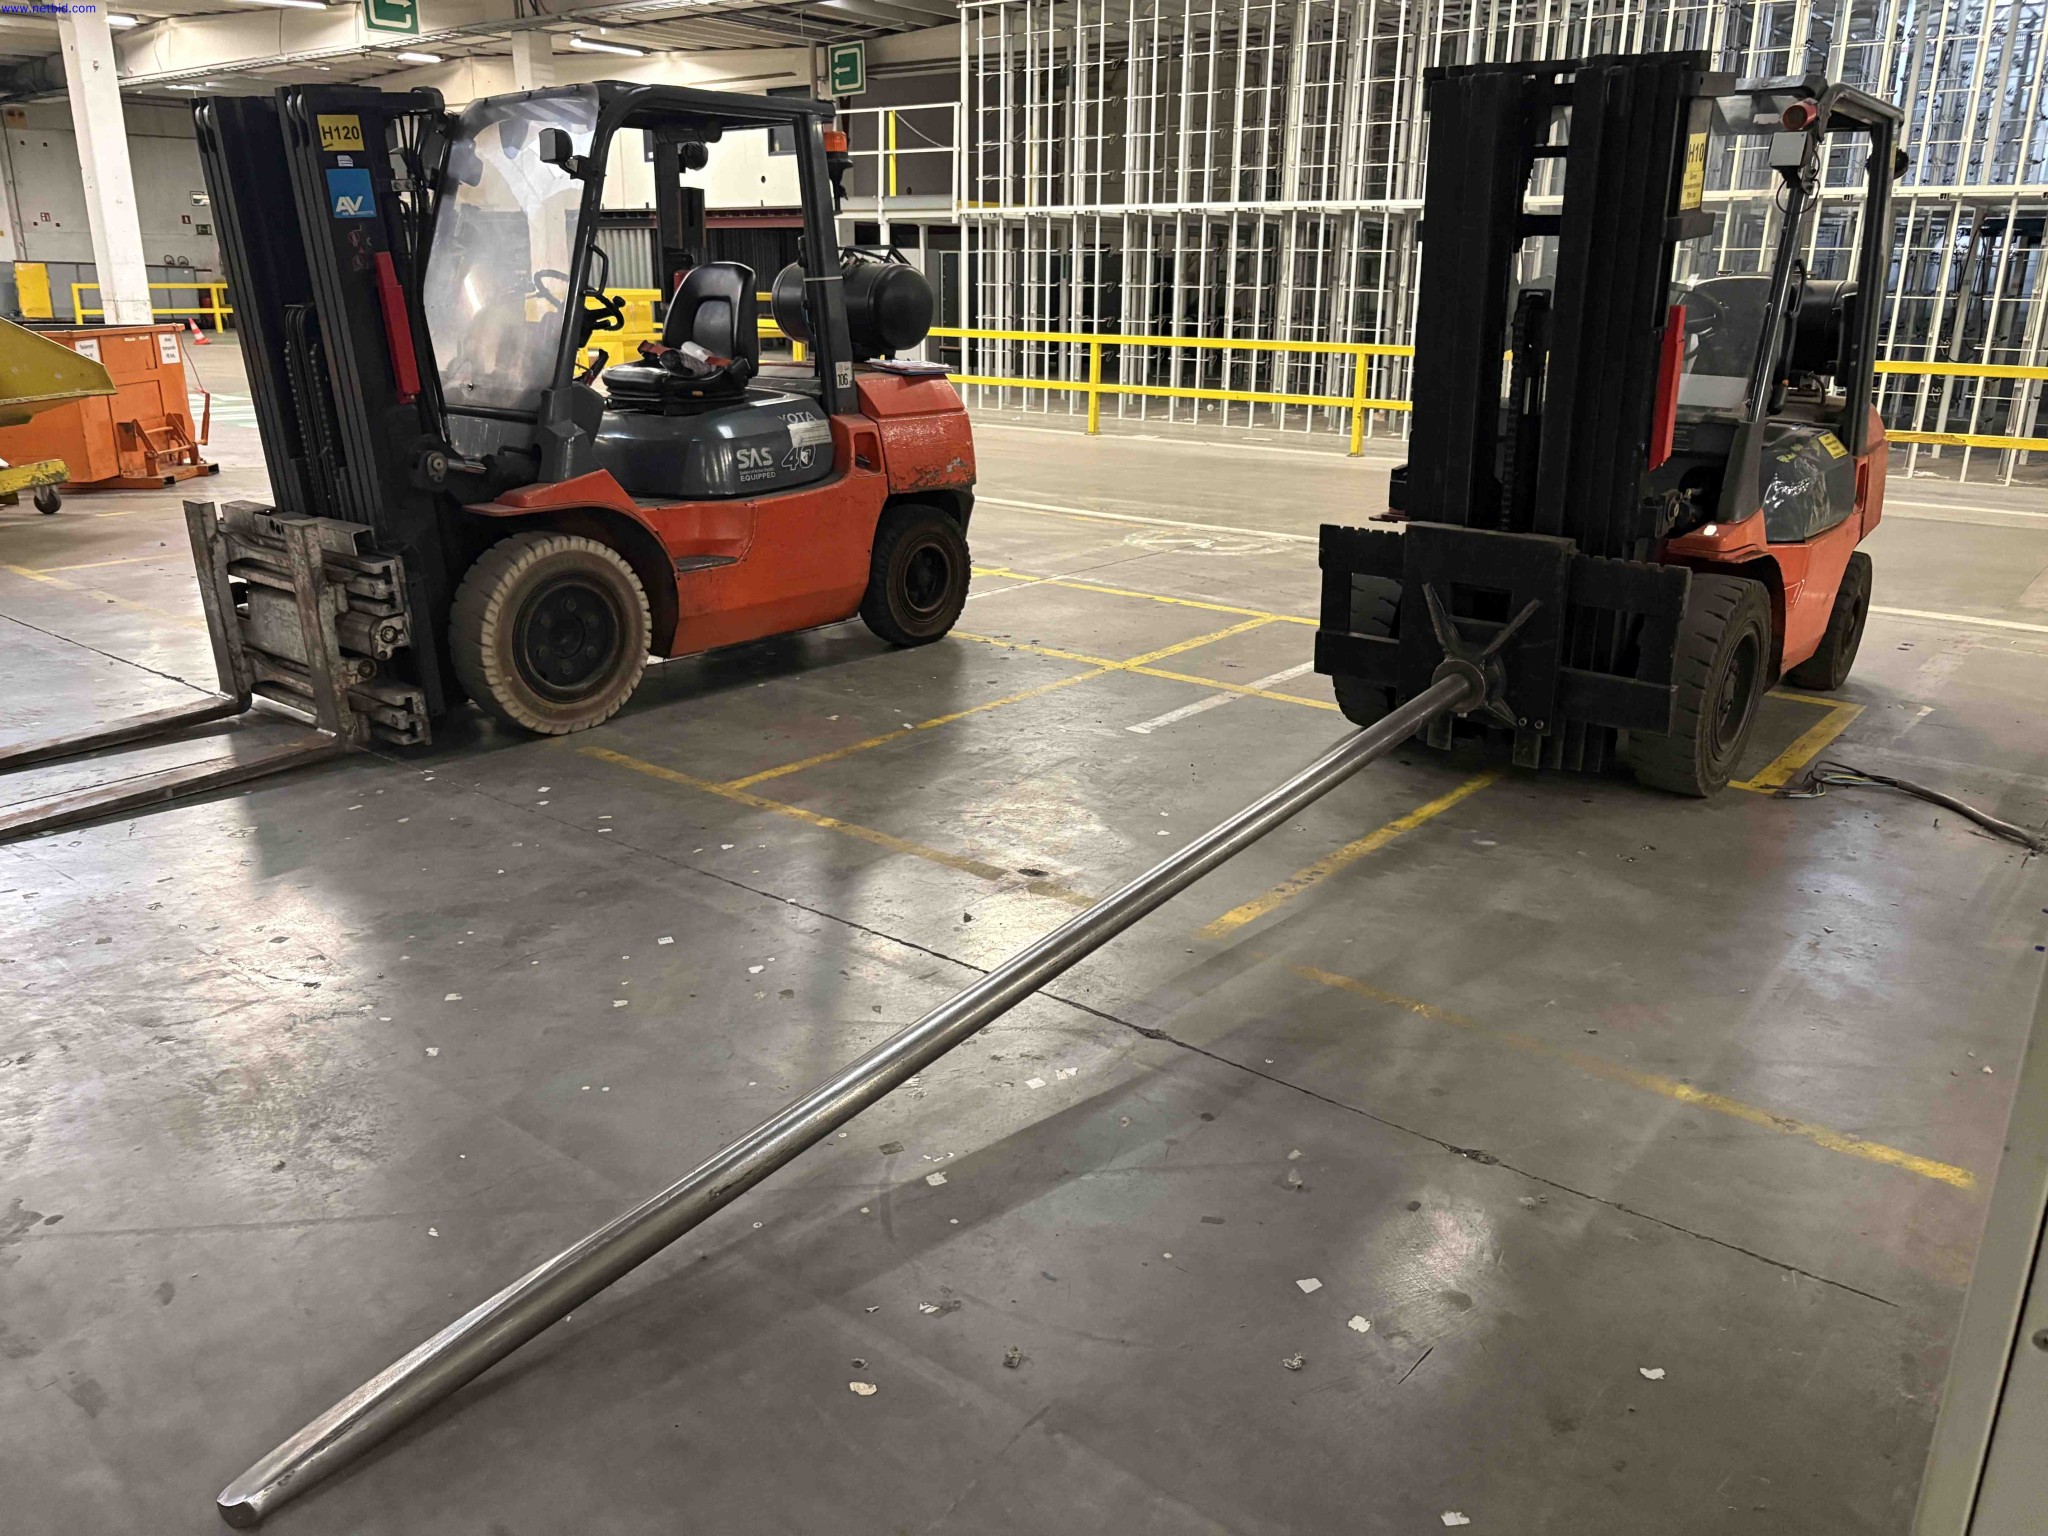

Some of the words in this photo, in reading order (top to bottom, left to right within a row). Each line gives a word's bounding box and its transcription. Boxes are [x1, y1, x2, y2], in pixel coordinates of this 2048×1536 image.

[321, 125, 360, 140] H120
[335, 195, 363, 216] AV
[736, 447, 774, 469] SAS
[781, 442, 817, 471] 40
[740, 471, 777, 482] EQUIPPED
